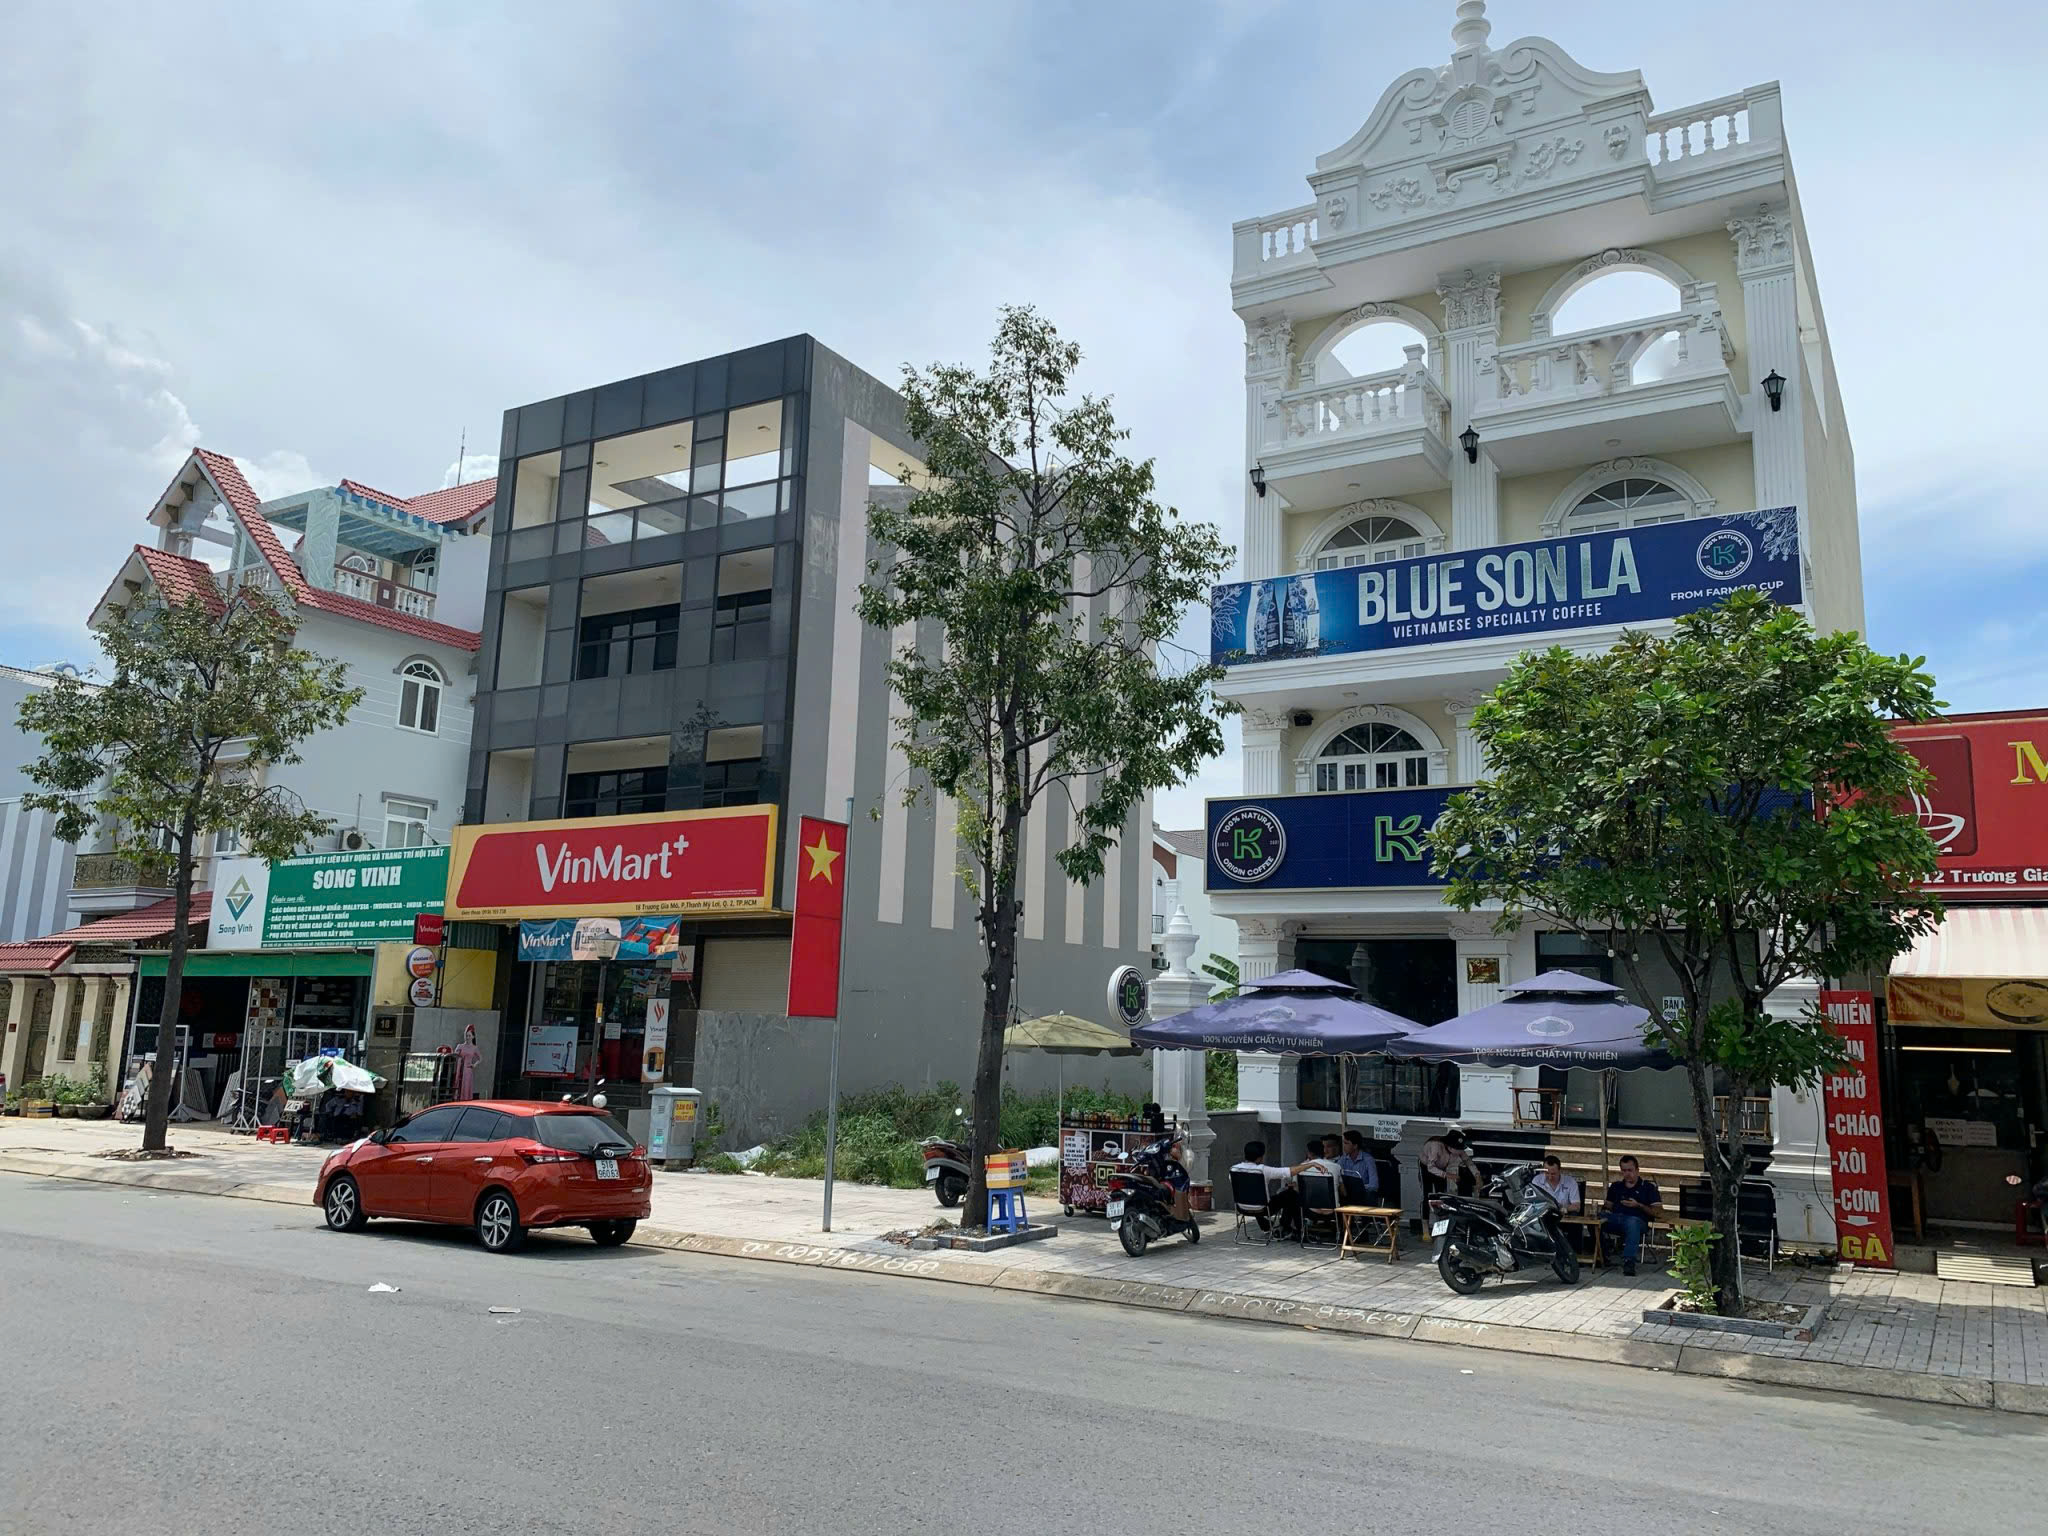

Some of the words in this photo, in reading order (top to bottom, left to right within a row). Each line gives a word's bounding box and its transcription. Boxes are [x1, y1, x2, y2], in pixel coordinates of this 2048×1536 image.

[1718, 534, 1744, 546] NATURAL
[1705, 564, 1725, 576] ORIGIN
[1724, 560, 1746, 576] COFFEE
[1359, 559, 1466, 626] BLUE
[1476, 544, 1568, 611] SON
[1580, 537, 1642, 599] LA
[1671, 589, 1703, 600] FROM
[1706, 585, 1739, 597] FARM
[1759, 580, 1784, 592] CUP
[1393, 617, 1471, 639] VIETNAMESE
[1477, 607, 1547, 630] SPECIALTY
[1552, 602, 1602, 622] COFFEE
[1222, 815, 1241, 834] 100%
[1241, 812, 1275, 833] NATURAL
[1233, 828, 1263, 859] K
[1222, 858, 1246, 876] ORIGIN
[1246, 855, 1275, 876] COFFEE
[312, 868, 357, 890] SONG
[361, 865, 402, 887] VINH
[1923, 872, 1945, 884] 12
[1950, 869, 2017, 884] Trương
[343, 903, 369, 911] MALAYSIA
[426, 900, 444, 908] CHINA
[218, 924, 236, 935] Song
[237, 923, 253, 934] Vinh
[1202, 1034, 1221, 1043] 100%
[1222, 1034, 1253, 1044] NGUYÊN
[1286, 1037, 1298, 1047] TỰ
[1298, 1037, 1324, 1047] NHIÊN
[1495, 1048, 1534, 1058] NGUYÊN
[1574, 1050, 1587, 1061] TỰ
[1588, 1051, 1618, 1060] NHIÊN
[601, 1160, 614, 1169] 51G
[1841, 1233, 1887, 1262] GÀ
